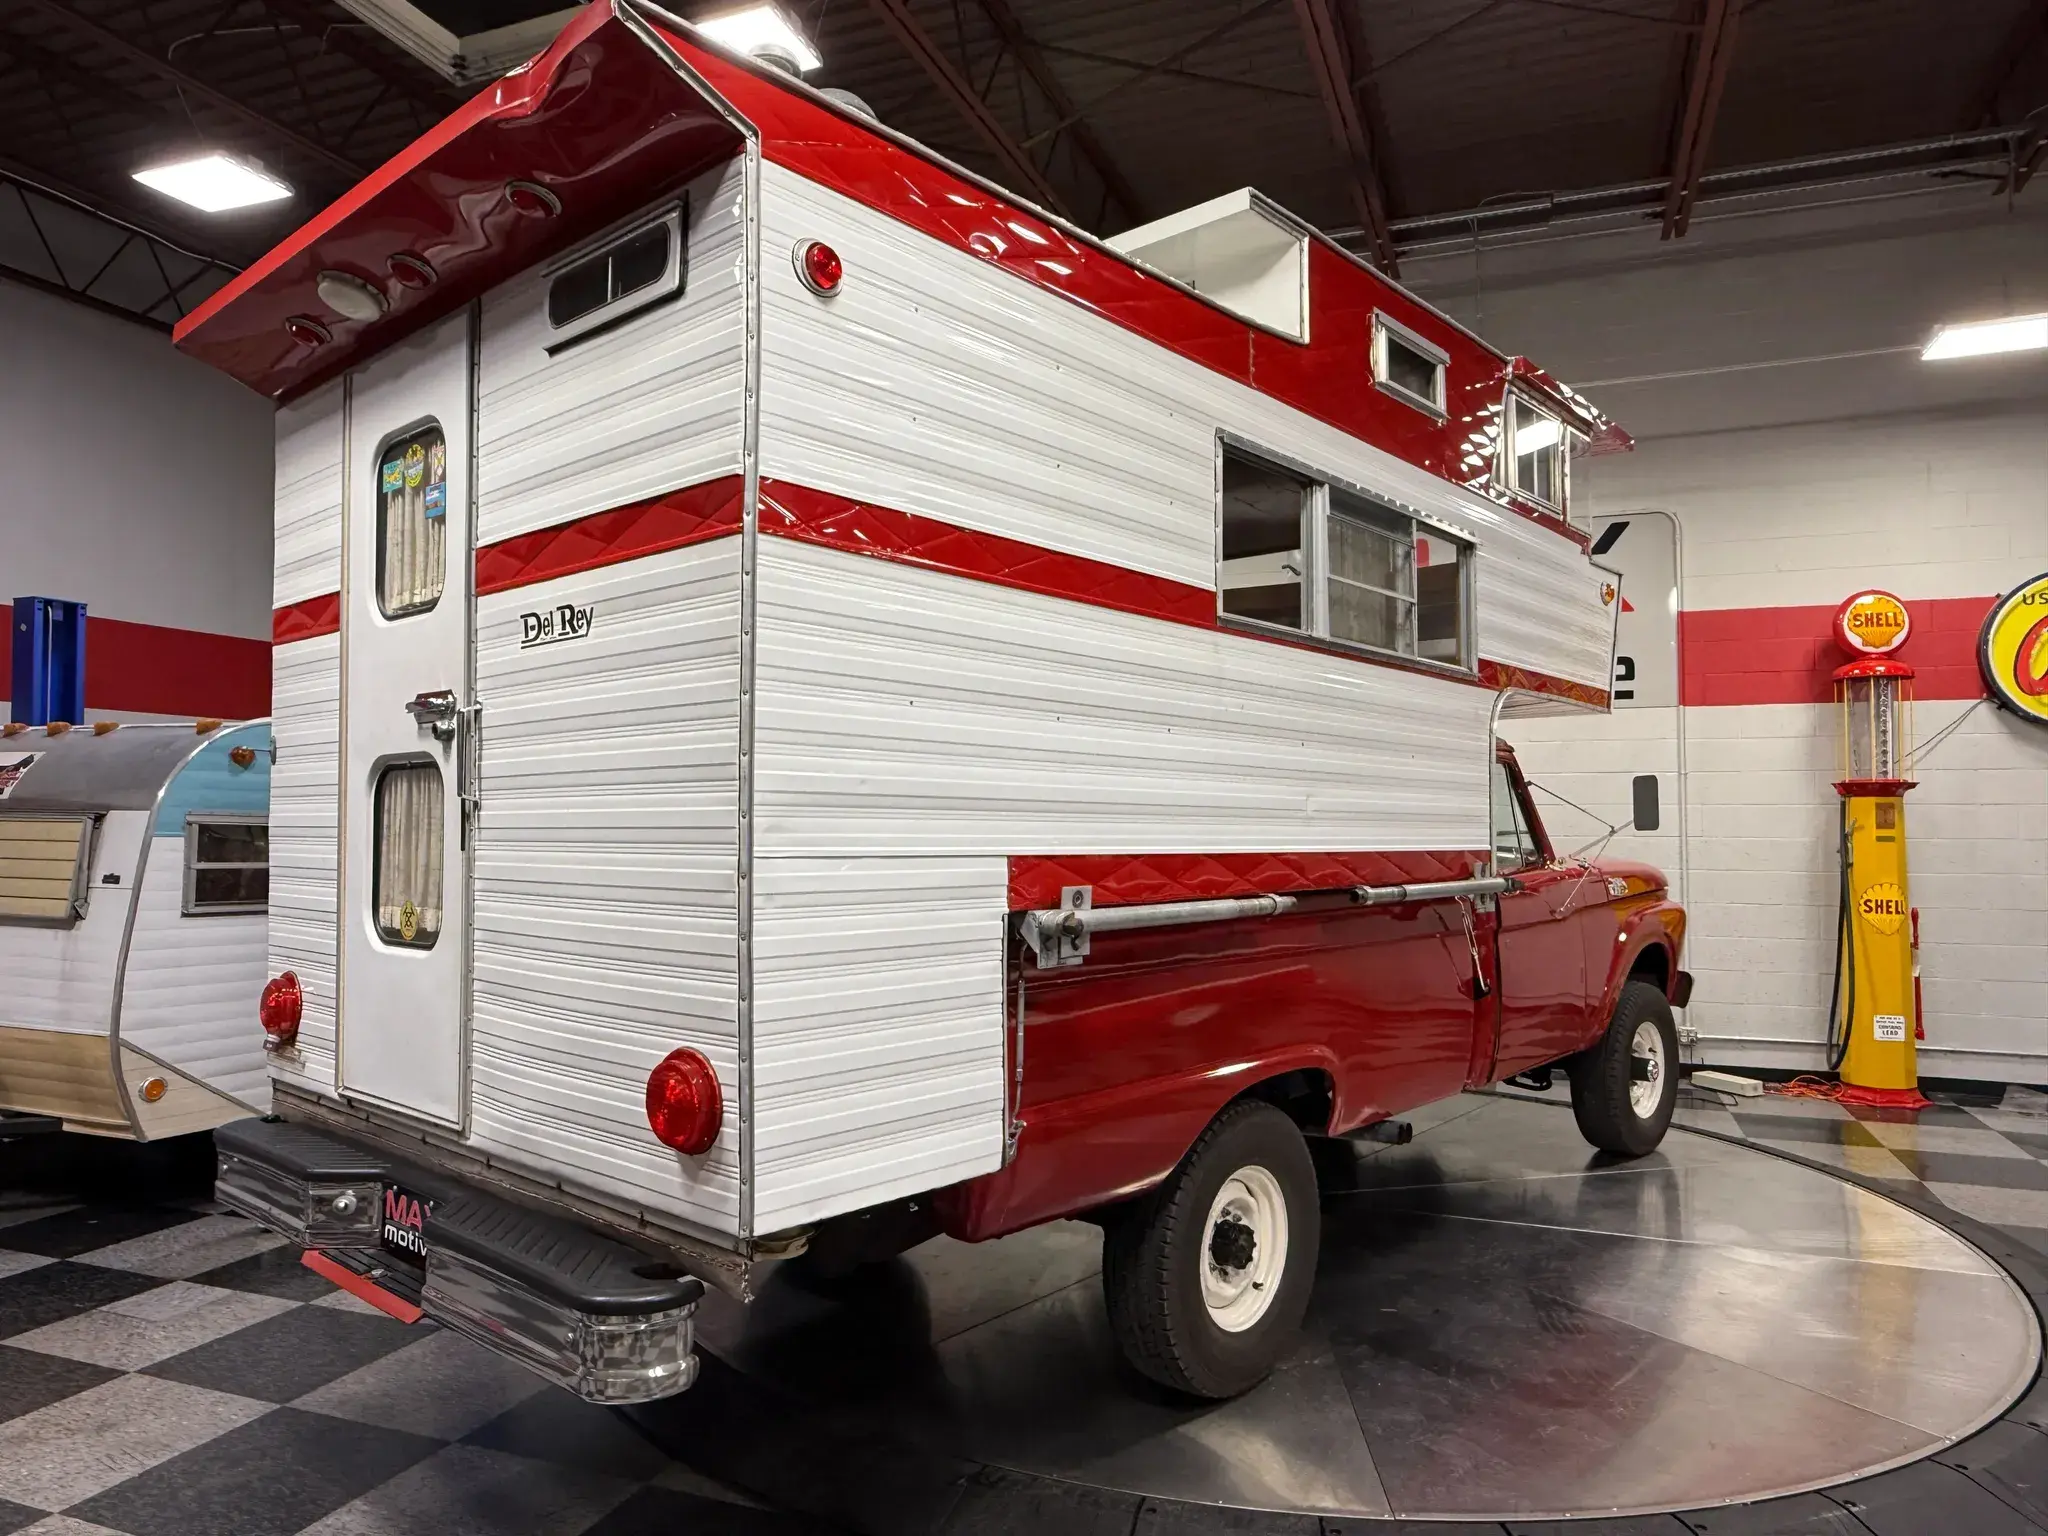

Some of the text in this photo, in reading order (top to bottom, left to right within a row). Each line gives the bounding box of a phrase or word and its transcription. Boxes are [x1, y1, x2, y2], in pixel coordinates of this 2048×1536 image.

[520, 604, 594, 645] Del Rey
[1852, 612, 1902, 628] SHELL
[1863, 898, 1905, 915] SHELL
[385, 1189, 432, 1233] MA
